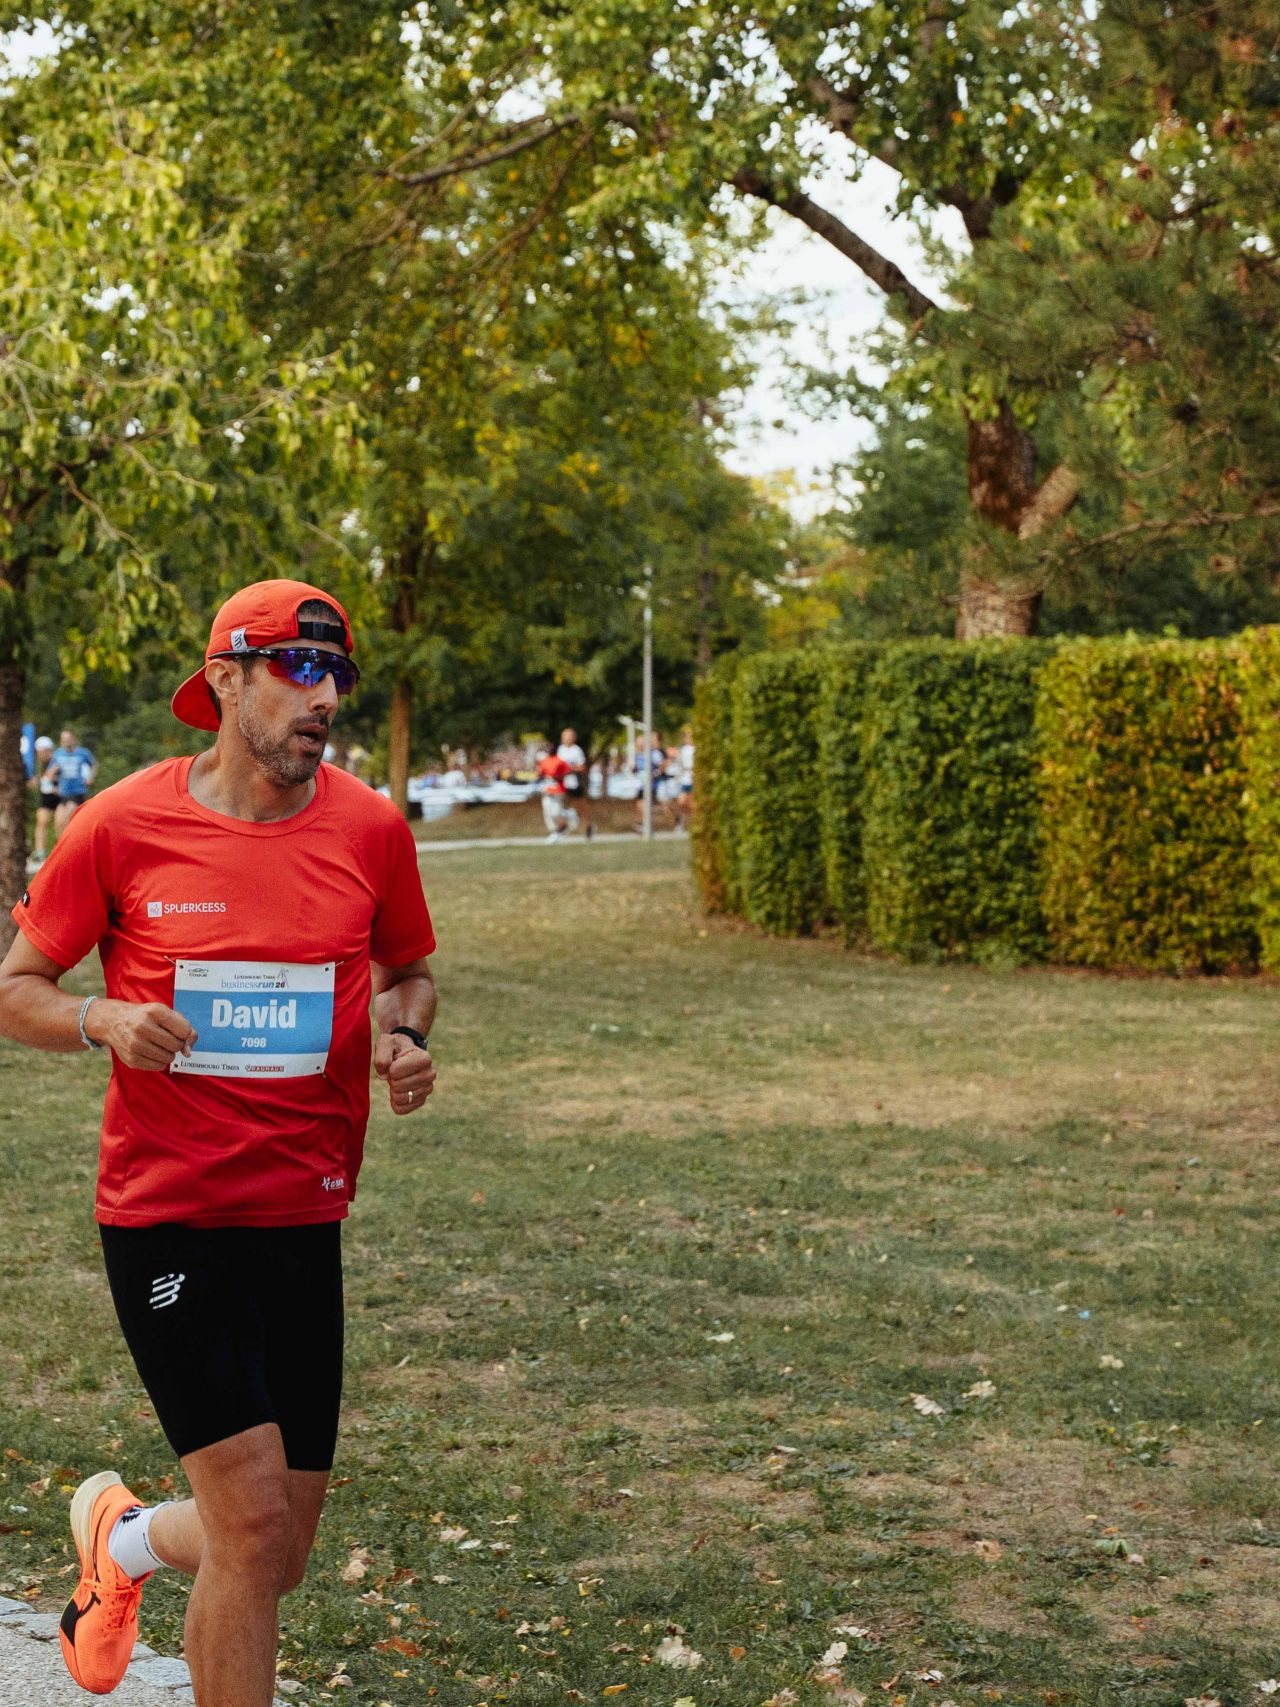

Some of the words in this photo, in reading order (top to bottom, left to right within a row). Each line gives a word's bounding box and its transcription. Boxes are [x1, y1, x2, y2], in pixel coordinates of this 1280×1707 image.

[164, 902, 226, 914] SPUERKEESS
[211, 999, 297, 1029] David
[241, 1037, 267, 1048] 7098
